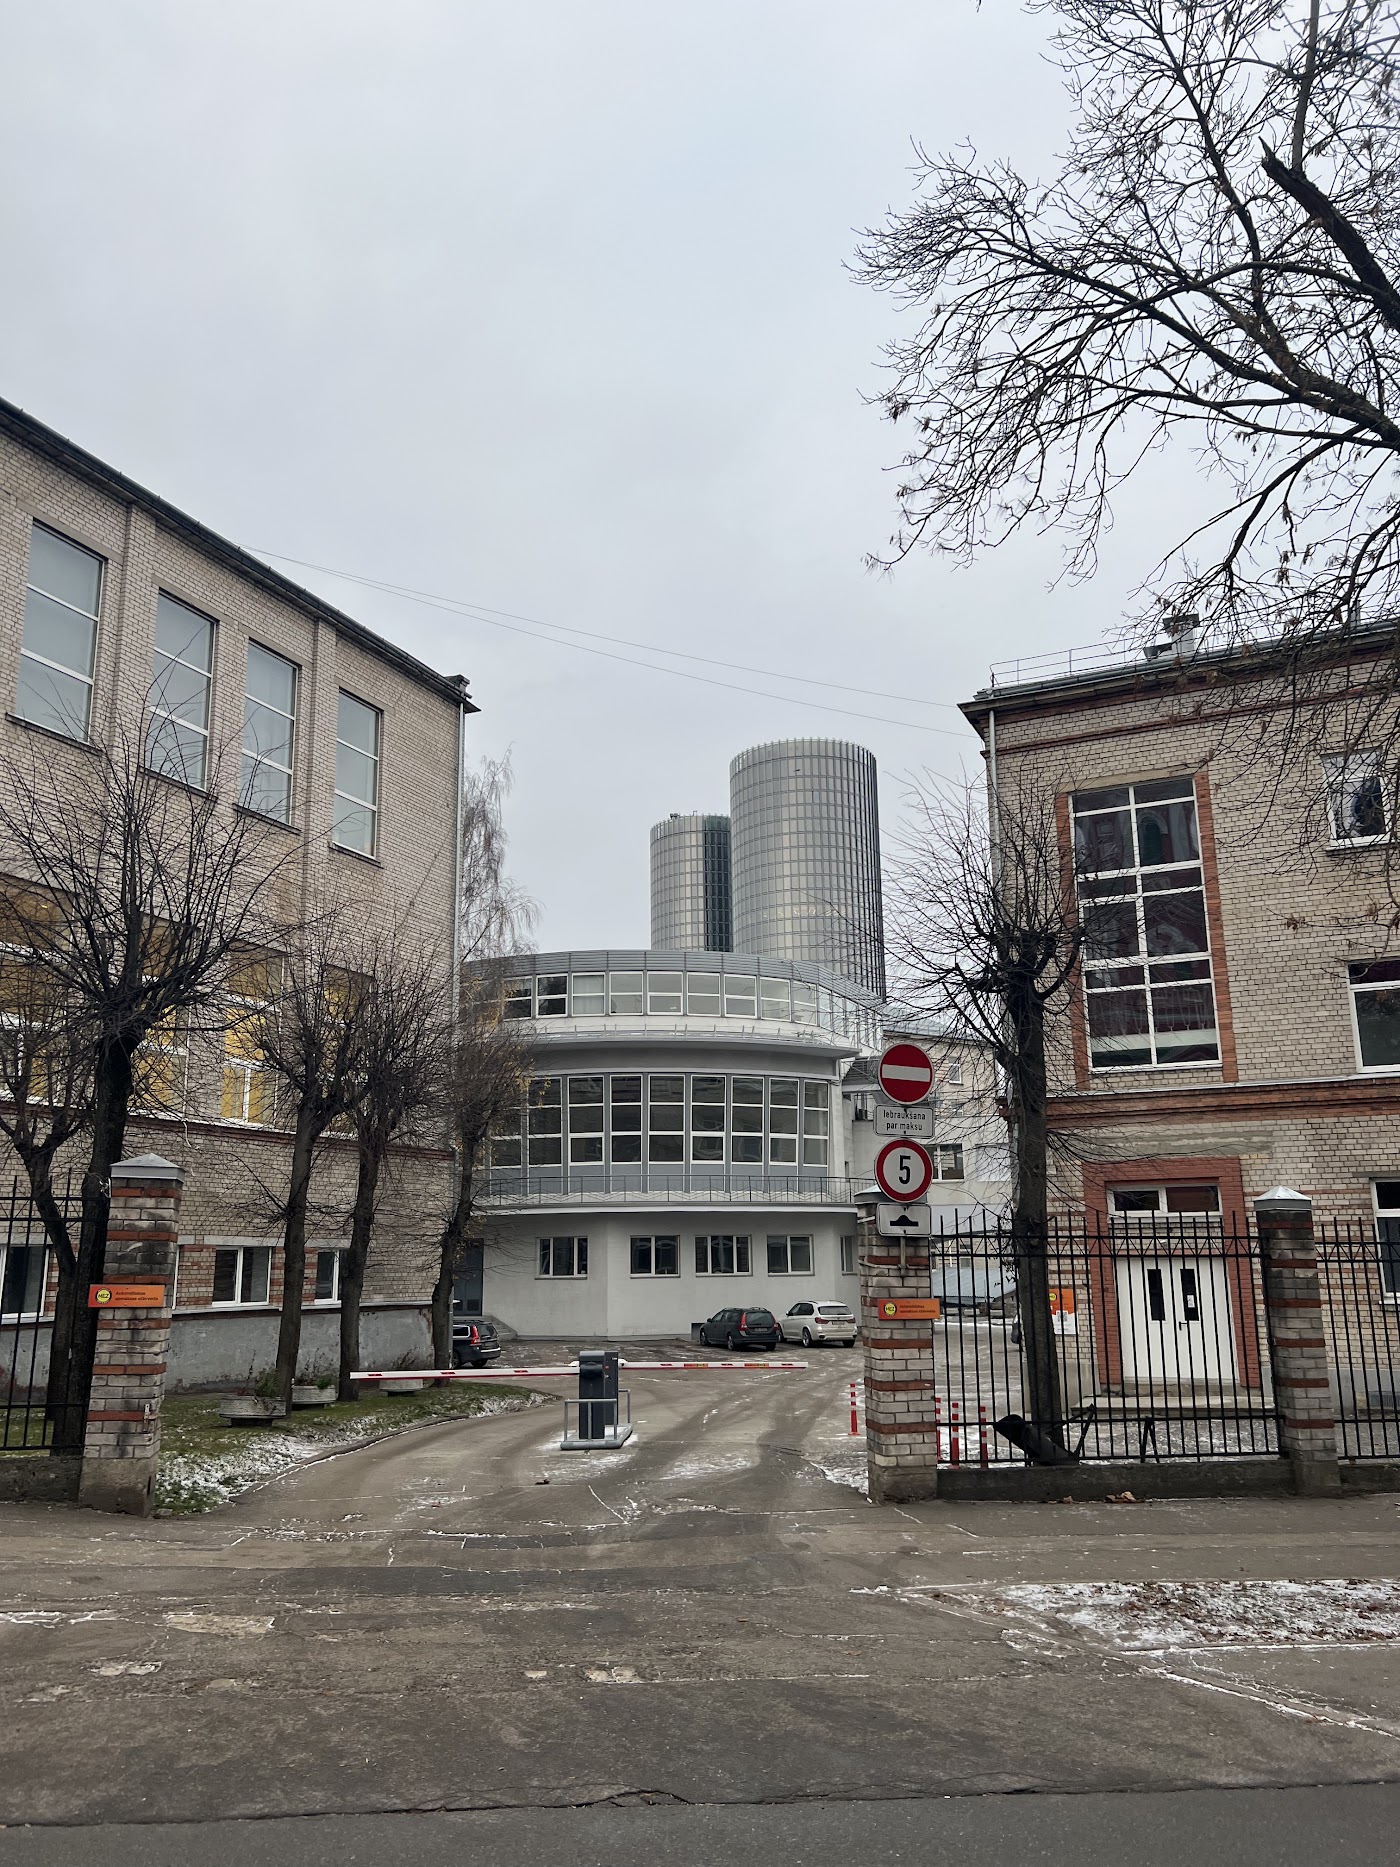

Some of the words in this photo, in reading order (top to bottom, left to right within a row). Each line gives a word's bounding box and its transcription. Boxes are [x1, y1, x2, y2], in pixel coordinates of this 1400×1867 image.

[883, 1109, 926, 1120] Iebraukšana
[886, 1122, 898, 1131] par
[899, 1122, 923, 1131] maksu
[898, 1155, 911, 1185] 5
